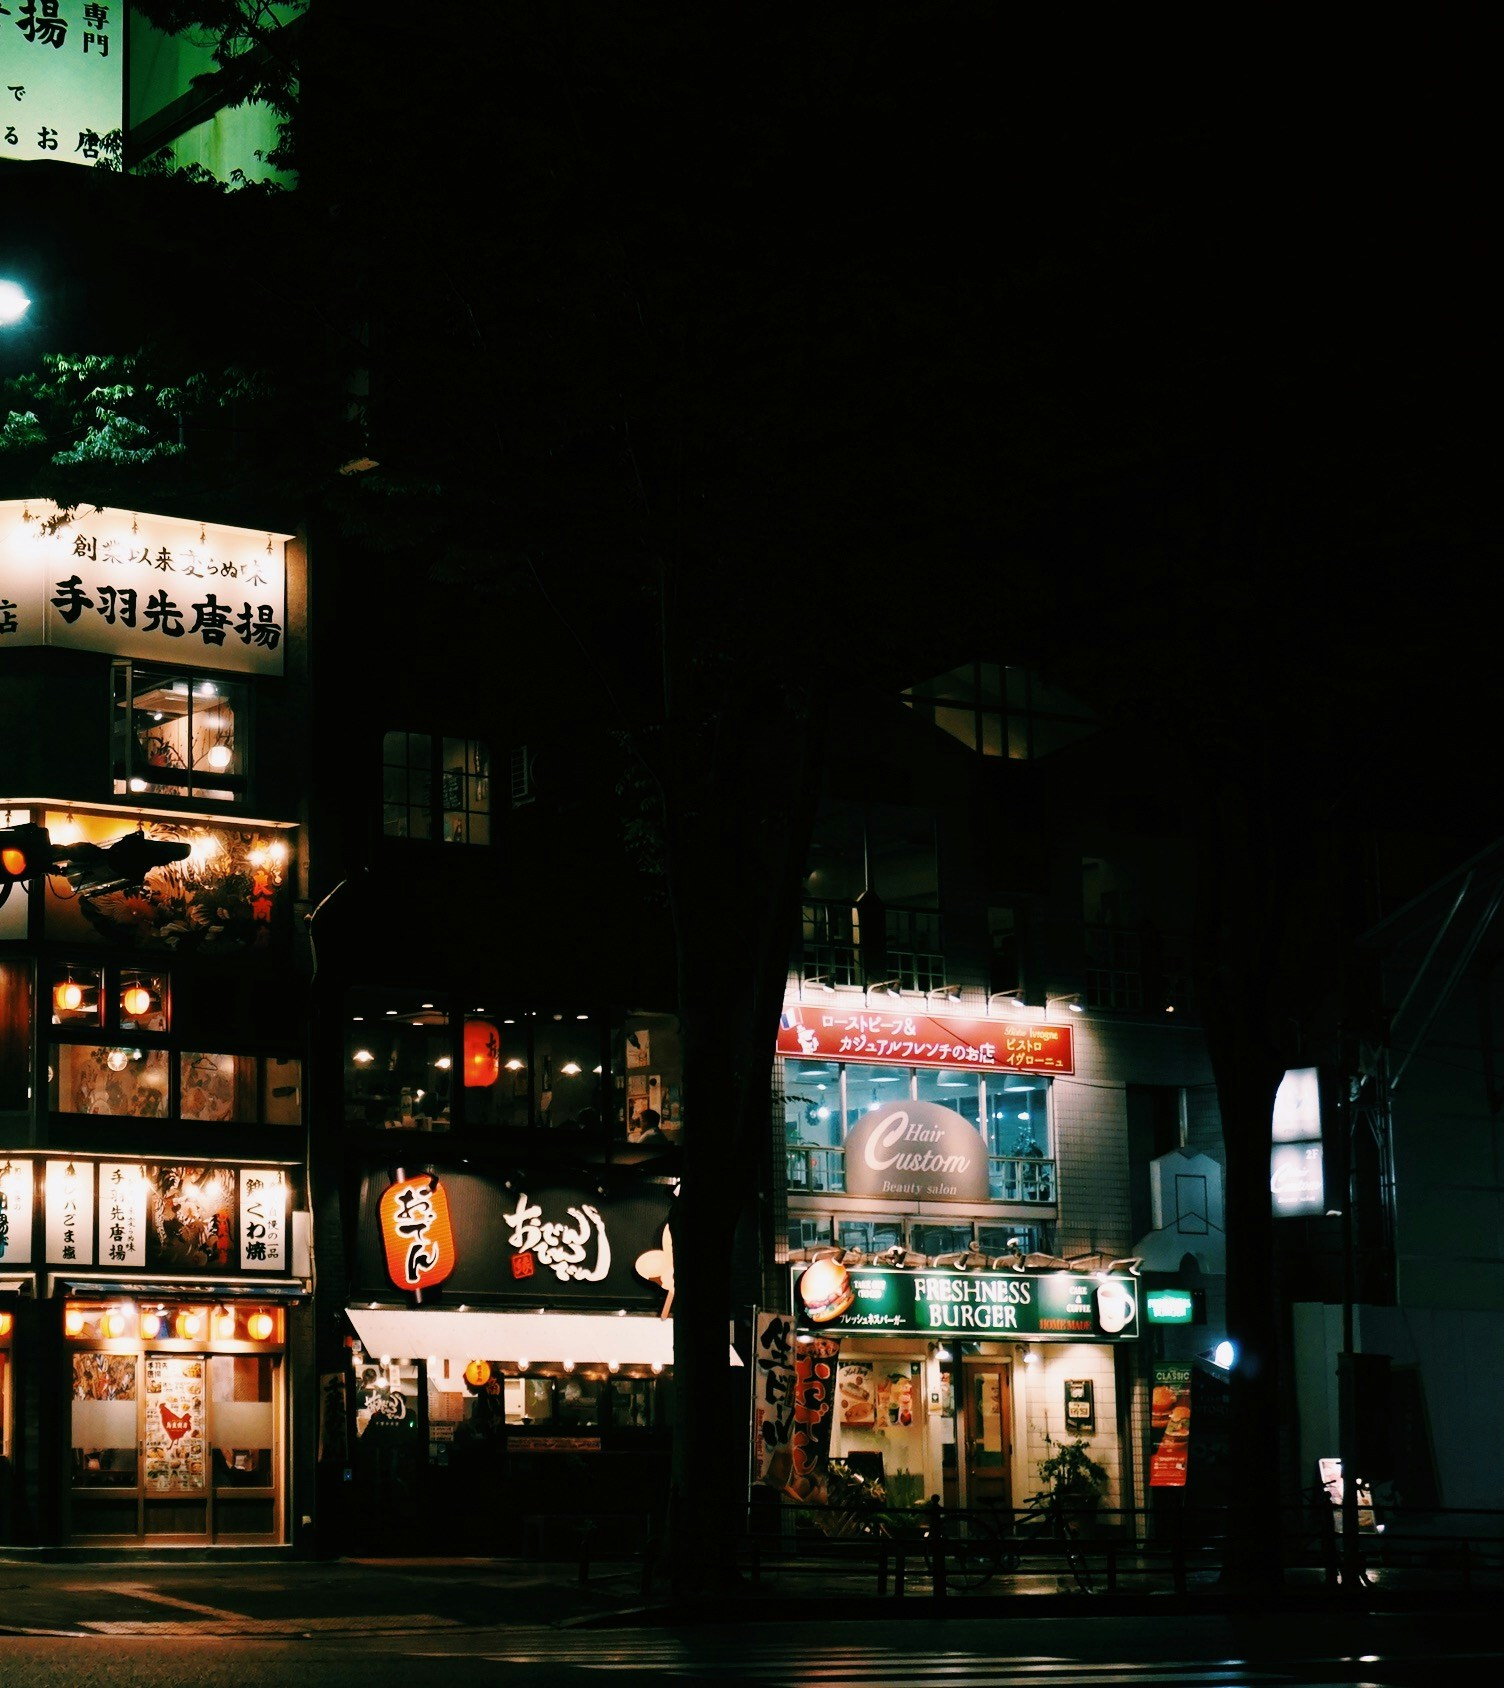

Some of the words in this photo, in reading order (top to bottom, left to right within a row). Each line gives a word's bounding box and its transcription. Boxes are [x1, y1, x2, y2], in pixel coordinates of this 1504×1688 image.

[50, 574, 283, 651] 手羽先唐揚
[864, 1110, 970, 1174] Custom
[902, 1123, 945, 1143] Hair
[882, 1180, 922, 1195] Beauty
[926, 1184, 957, 1196] salon
[914, 1278, 1031, 1304] FRESHNESS
[929, 1304, 1018, 1329] BURGER
[1155, 1371, 1191, 1382] CLASSIC
